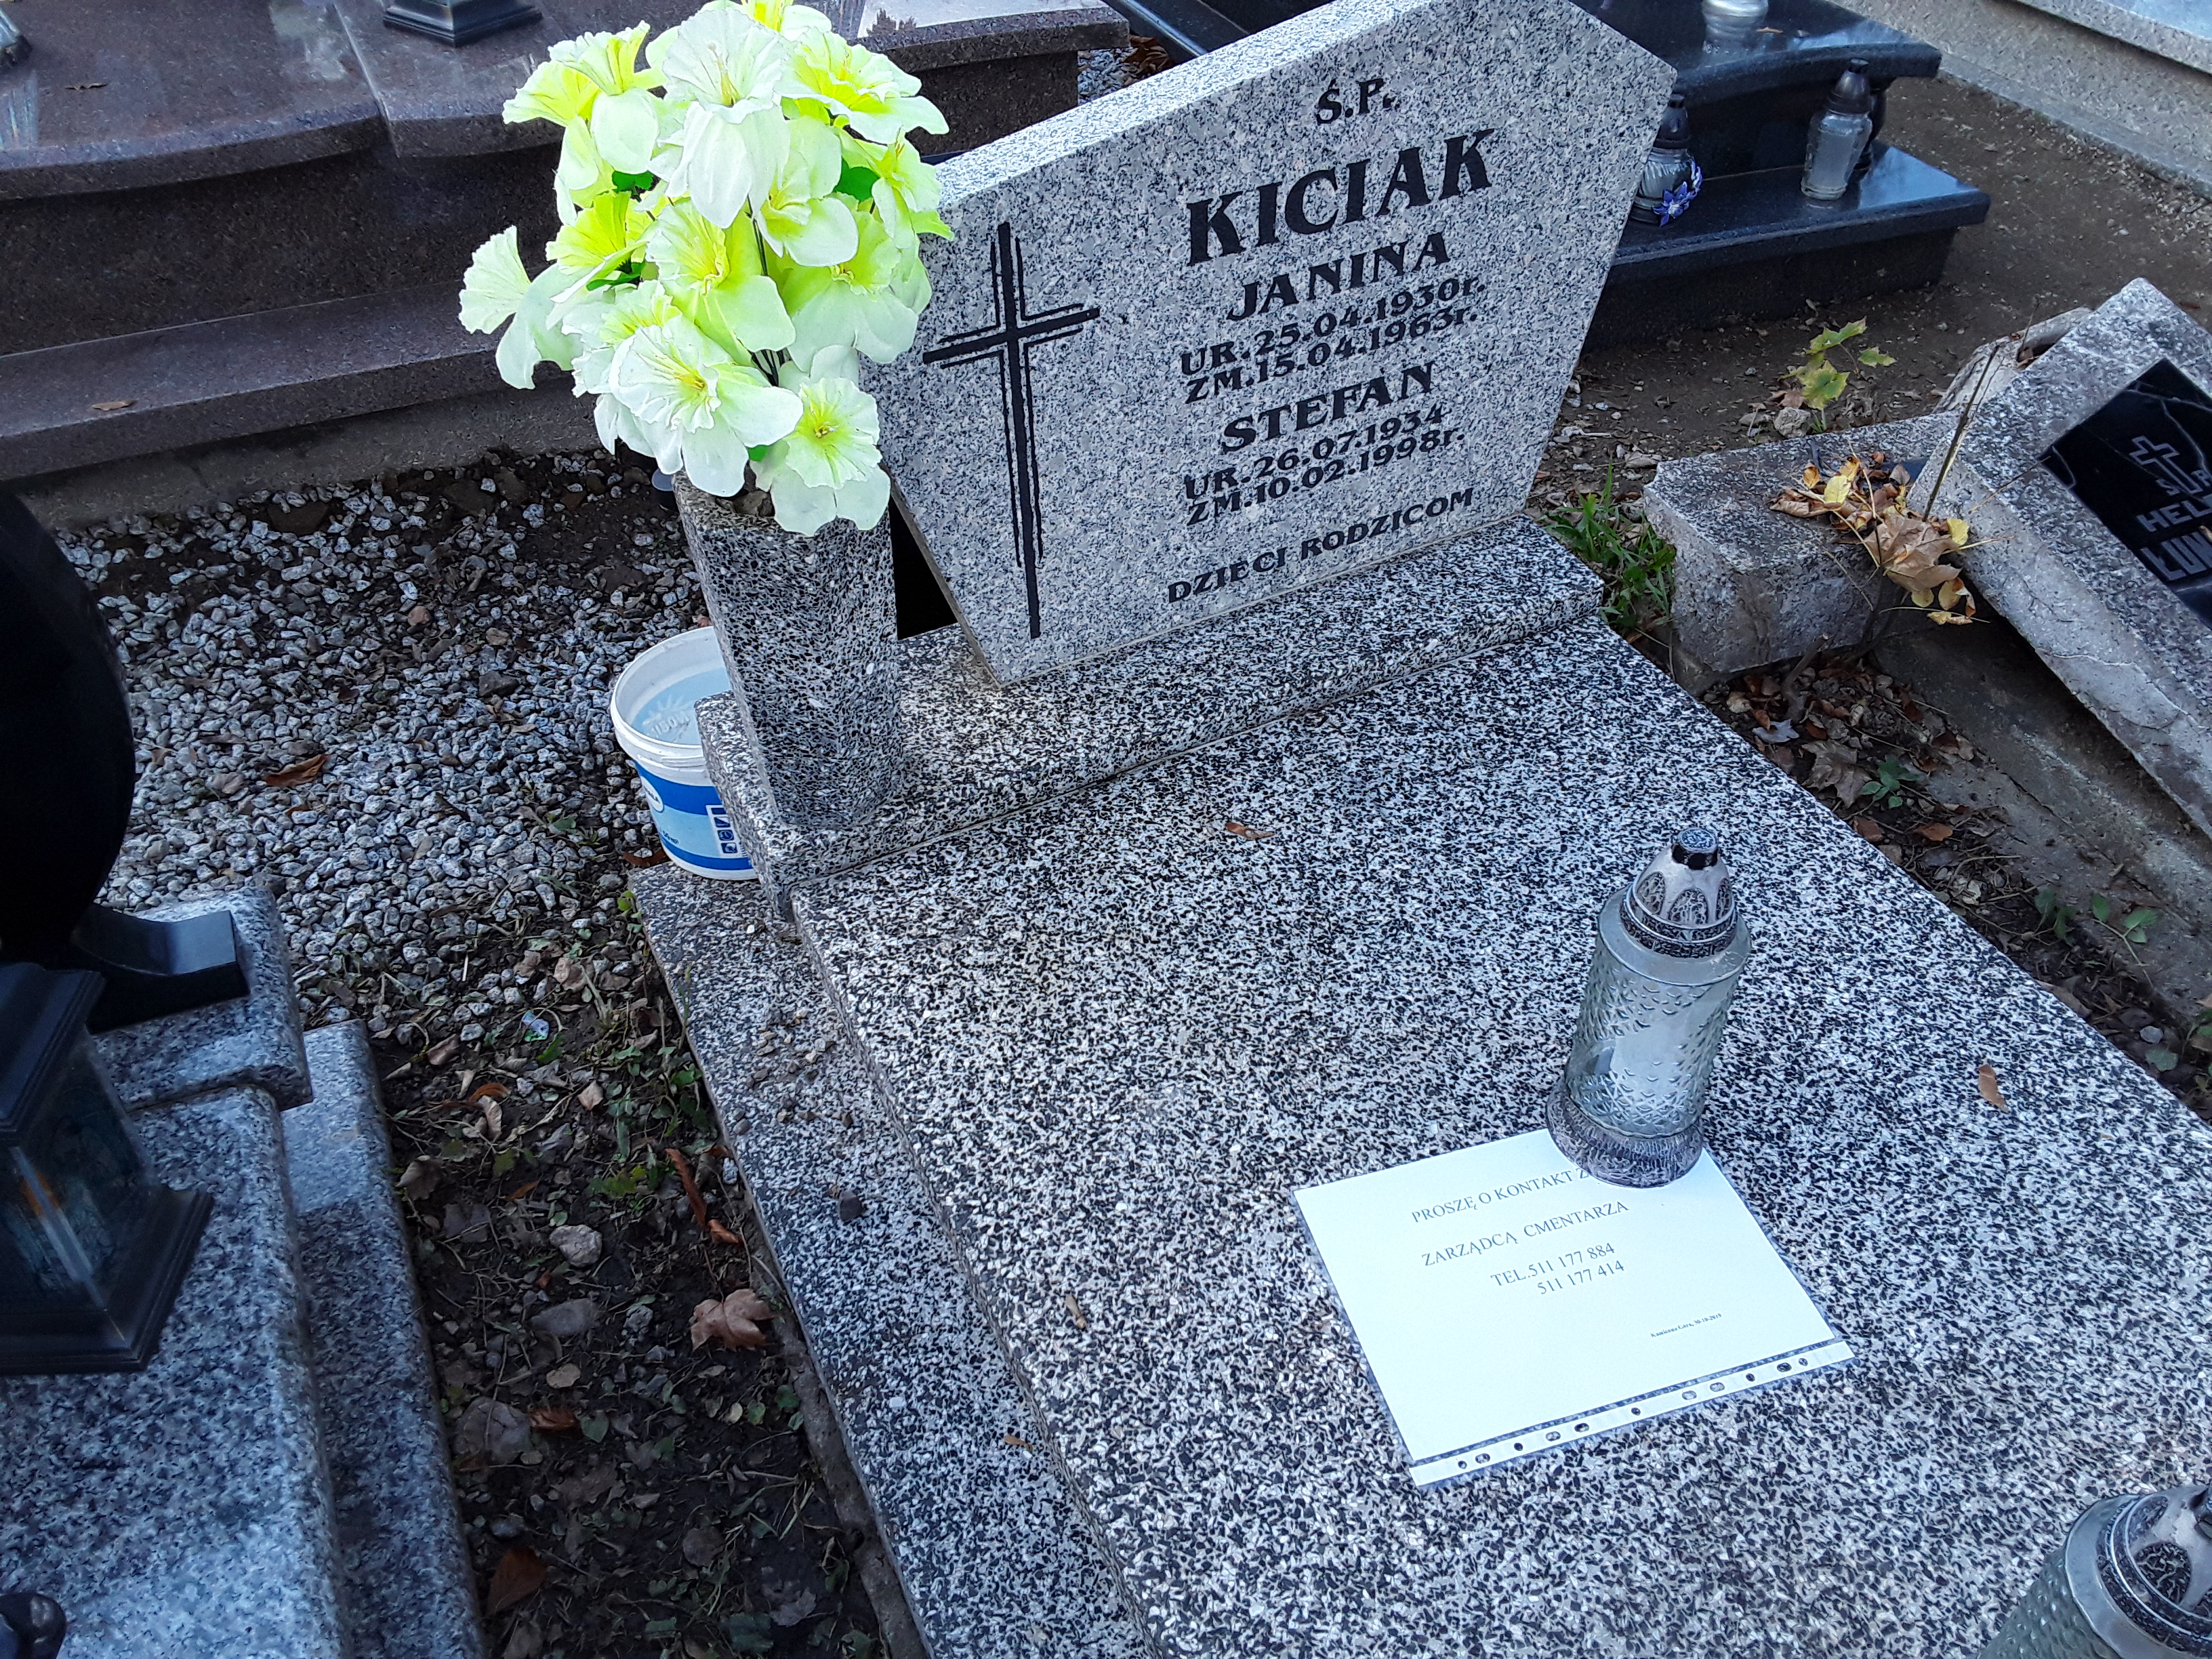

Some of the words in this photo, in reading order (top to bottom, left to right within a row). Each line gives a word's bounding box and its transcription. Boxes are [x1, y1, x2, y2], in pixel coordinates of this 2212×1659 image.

[1187, 128, 1494, 267] KICIAK
[1227, 232, 1450, 321] JANINA
[1221, 361, 1435, 452] STEFAN
[2136, 493, 2212, 532] HEL
[1168, 548, 1286, 603] DZIECI
[1300, 489, 1473, 560] RODZICOM
[1412, 1197, 1478, 1223] PROSZĘ
[1478, 1191, 1492, 1204] O
[1494, 1170, 1572, 1200] KONTAKT
[1523, 1200, 1630, 1237] CMENTARZA
[1537, 1277, 1563, 1294] 511
[1567, 1269, 1593, 1288] 177
[1597, 1260, 1624, 1278] 414
[1558, 1250, 1584, 1268] 177
[1587, 1242, 1615, 1261] 884
